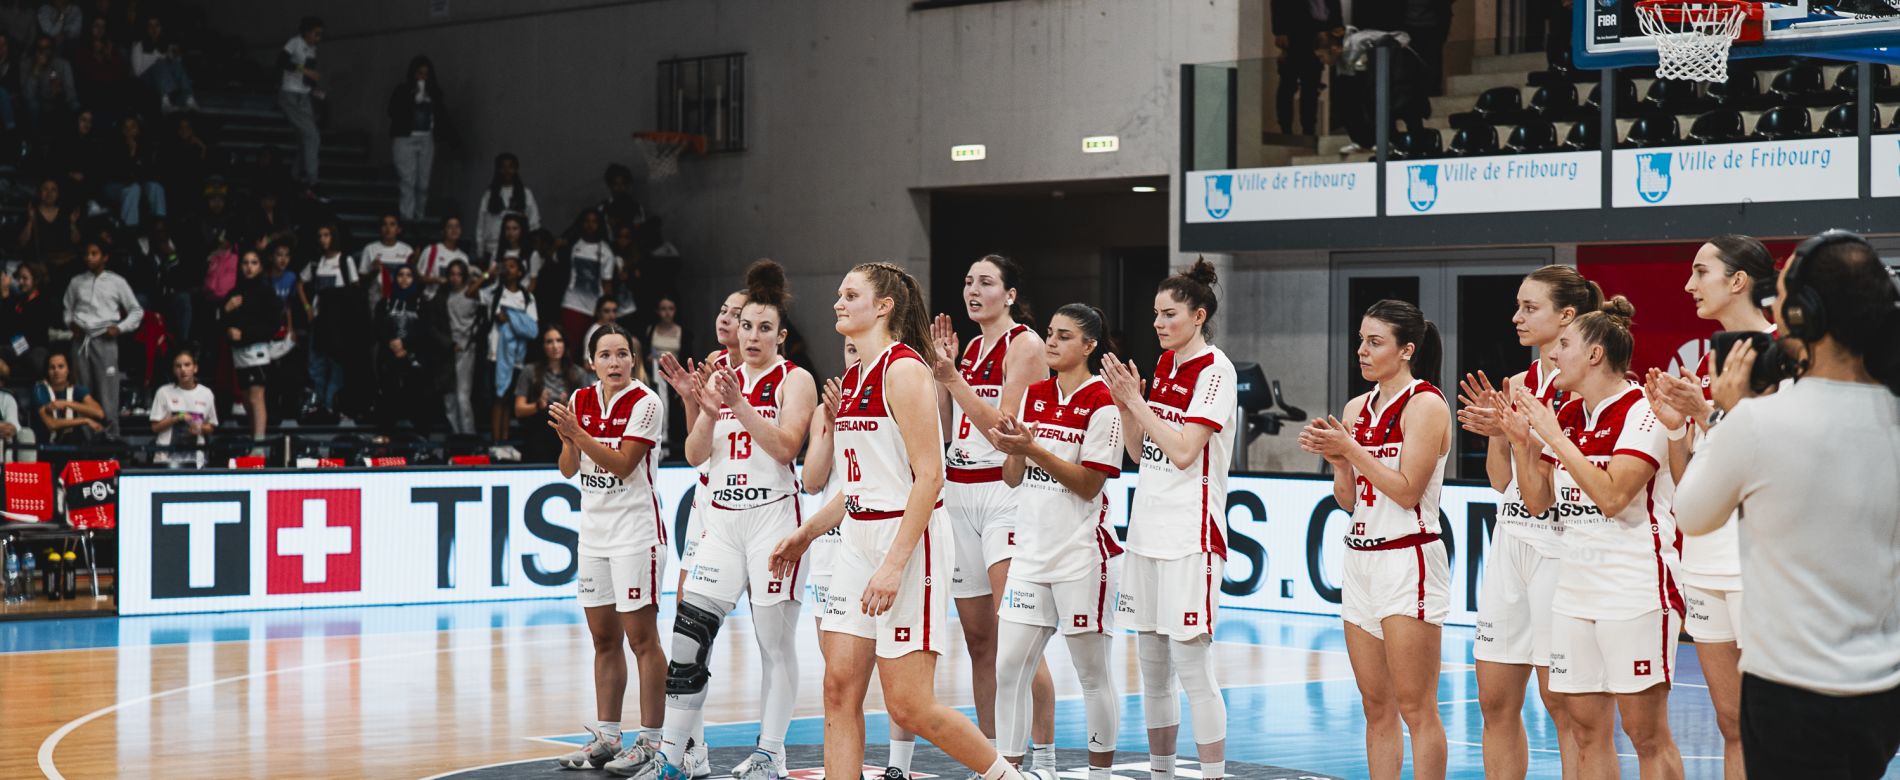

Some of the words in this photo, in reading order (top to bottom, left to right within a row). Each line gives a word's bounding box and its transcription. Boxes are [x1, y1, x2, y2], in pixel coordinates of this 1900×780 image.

[1597, 14, 1617, 27] FIBA
[1678, 151, 1717, 171] Ville
[1723, 149, 1743, 169] de
[1750, 147, 1831, 169] Fribourg
[1444, 163, 1477, 182] Ville
[1483, 162, 1500, 180] de
[1507, 160, 1578, 180] Fribourg
[1236, 174, 1266, 191] Ville
[1272, 172, 1288, 190] de
[1293, 171, 1356, 190] Fribourg
[834, 420, 879, 431] TZERLAND
[1036, 427, 1085, 445] TZERLAN
[728, 431, 752, 460] 13
[844, 449, 862, 482] 18
[713, 487, 772, 501] TISSOT
[1013, 590, 1035, 599] Hôpital
[833, 608, 847, 616] Tour
[1481, 634, 1494, 642] Tour
